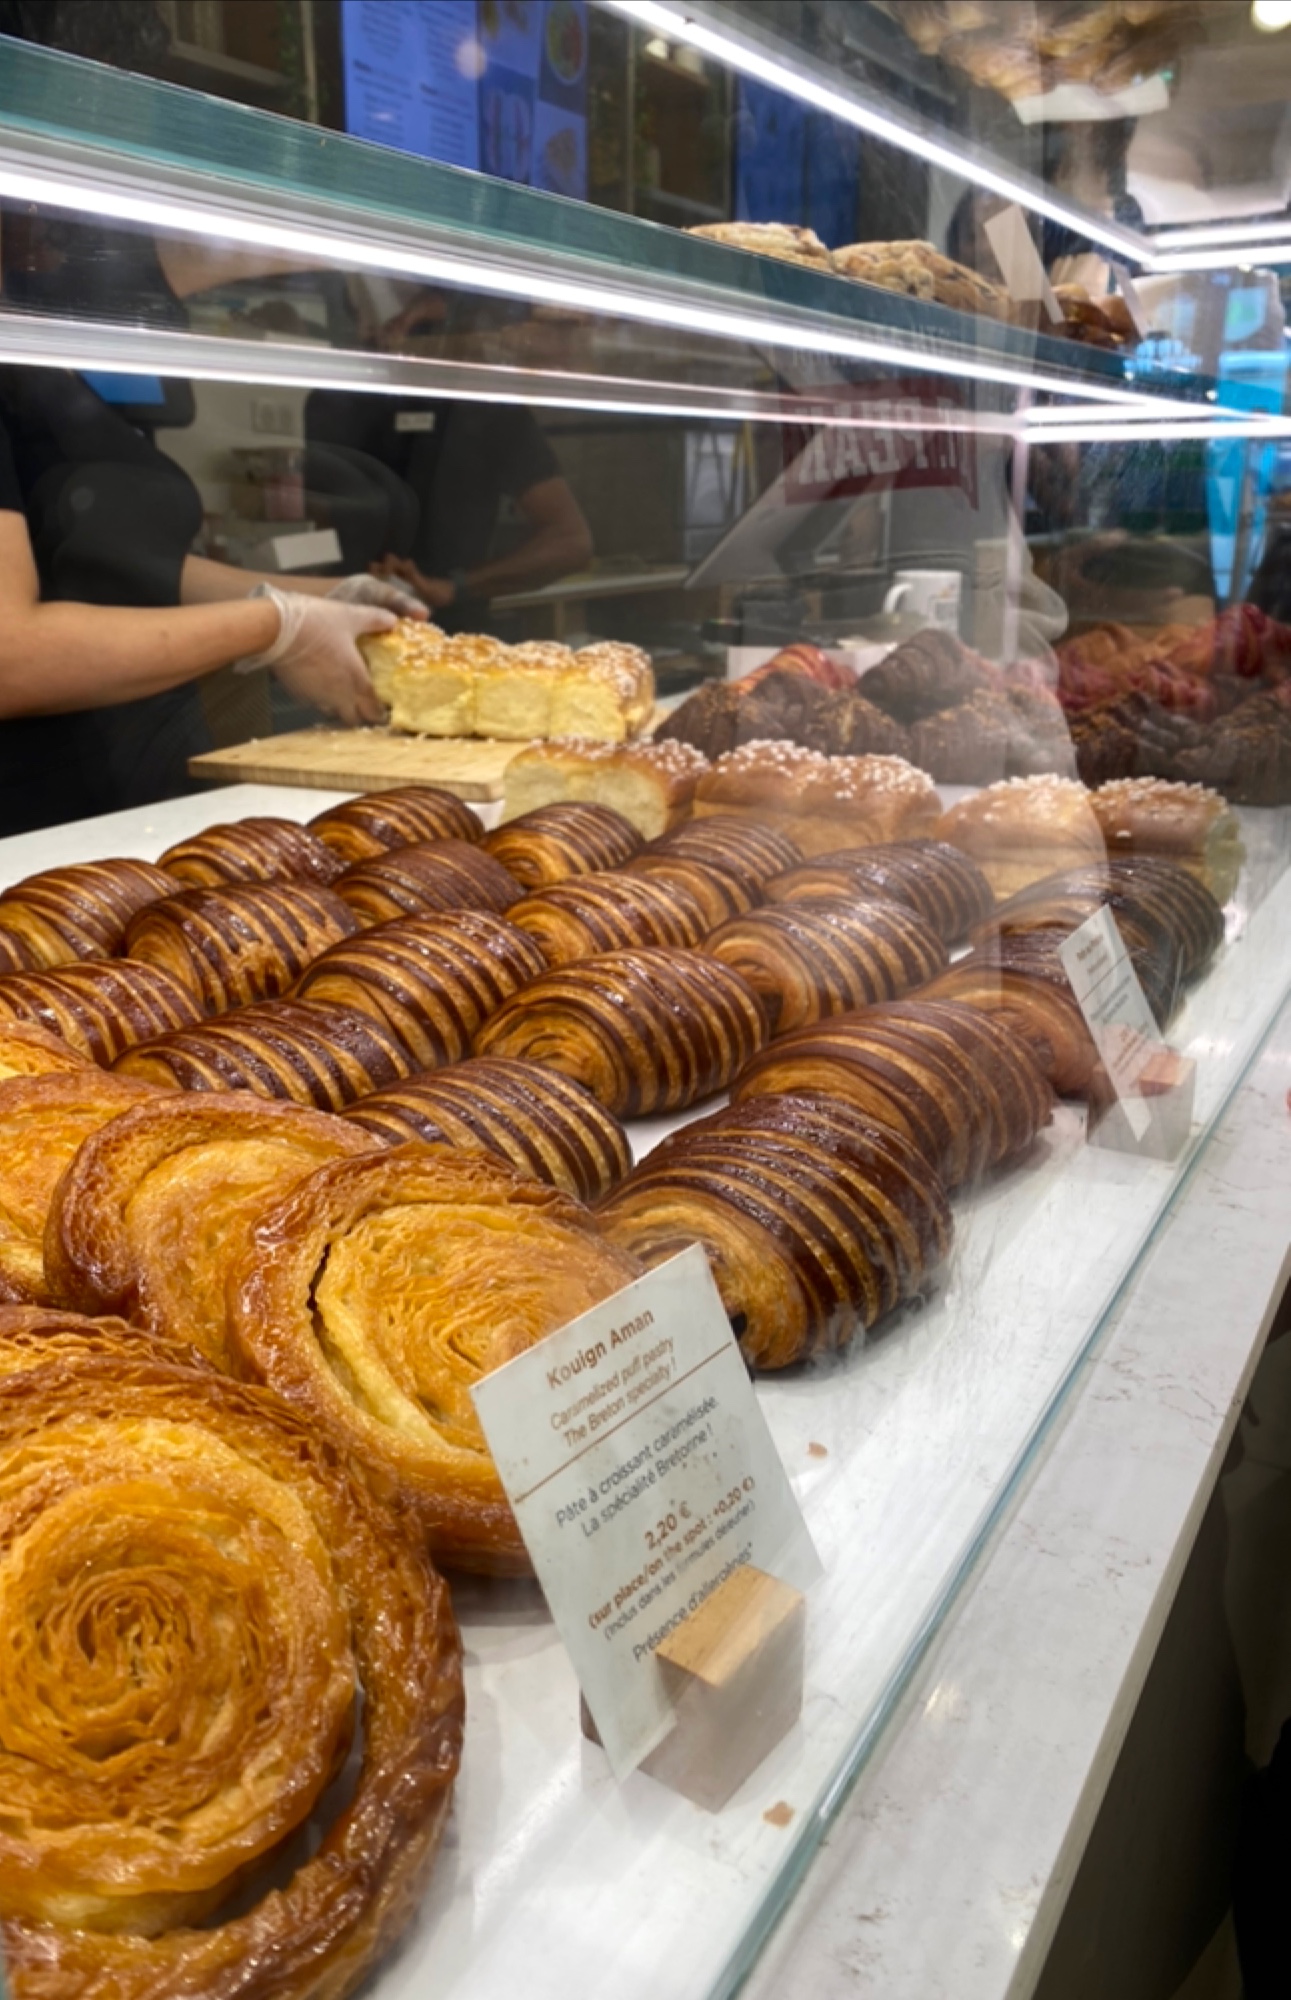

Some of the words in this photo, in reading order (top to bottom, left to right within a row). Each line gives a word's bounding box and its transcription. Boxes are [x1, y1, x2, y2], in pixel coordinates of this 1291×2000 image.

[546, 1341, 607, 1390] Kouign
[609, 1310, 654, 1349] Aman
[550, 1371, 619, 1430] Caramelized
[621, 1355, 641, 1385] puff
[643, 1337, 673, 1369] pastry
[564, 1425, 587, 1446] The
[588, 1397, 625, 1431] Breton
[556, 1498, 588, 1527] Pâte
[588, 1487, 599, 1503] à
[599, 1445, 652, 1494] croissant
[581, 1517, 600, 1537] La
[601, 1469, 656, 1523] spécialité
[655, 1429, 707, 1477] Bretonne
[645, 1513, 677, 1549] 2,20
[679, 1500, 691, 1519] €
[588, 1603, 611, 1629] (sur
[613, 1558, 663, 1609] place/on
[663, 1542, 682, 1561] the
[683, 1519, 707, 1545] spot
[605, 1606, 638, 1640] (inclus
[639, 1584, 662, 1609] dans
[661, 1571, 676, 1588] les
[632, 1607, 687, 1662] Présence
